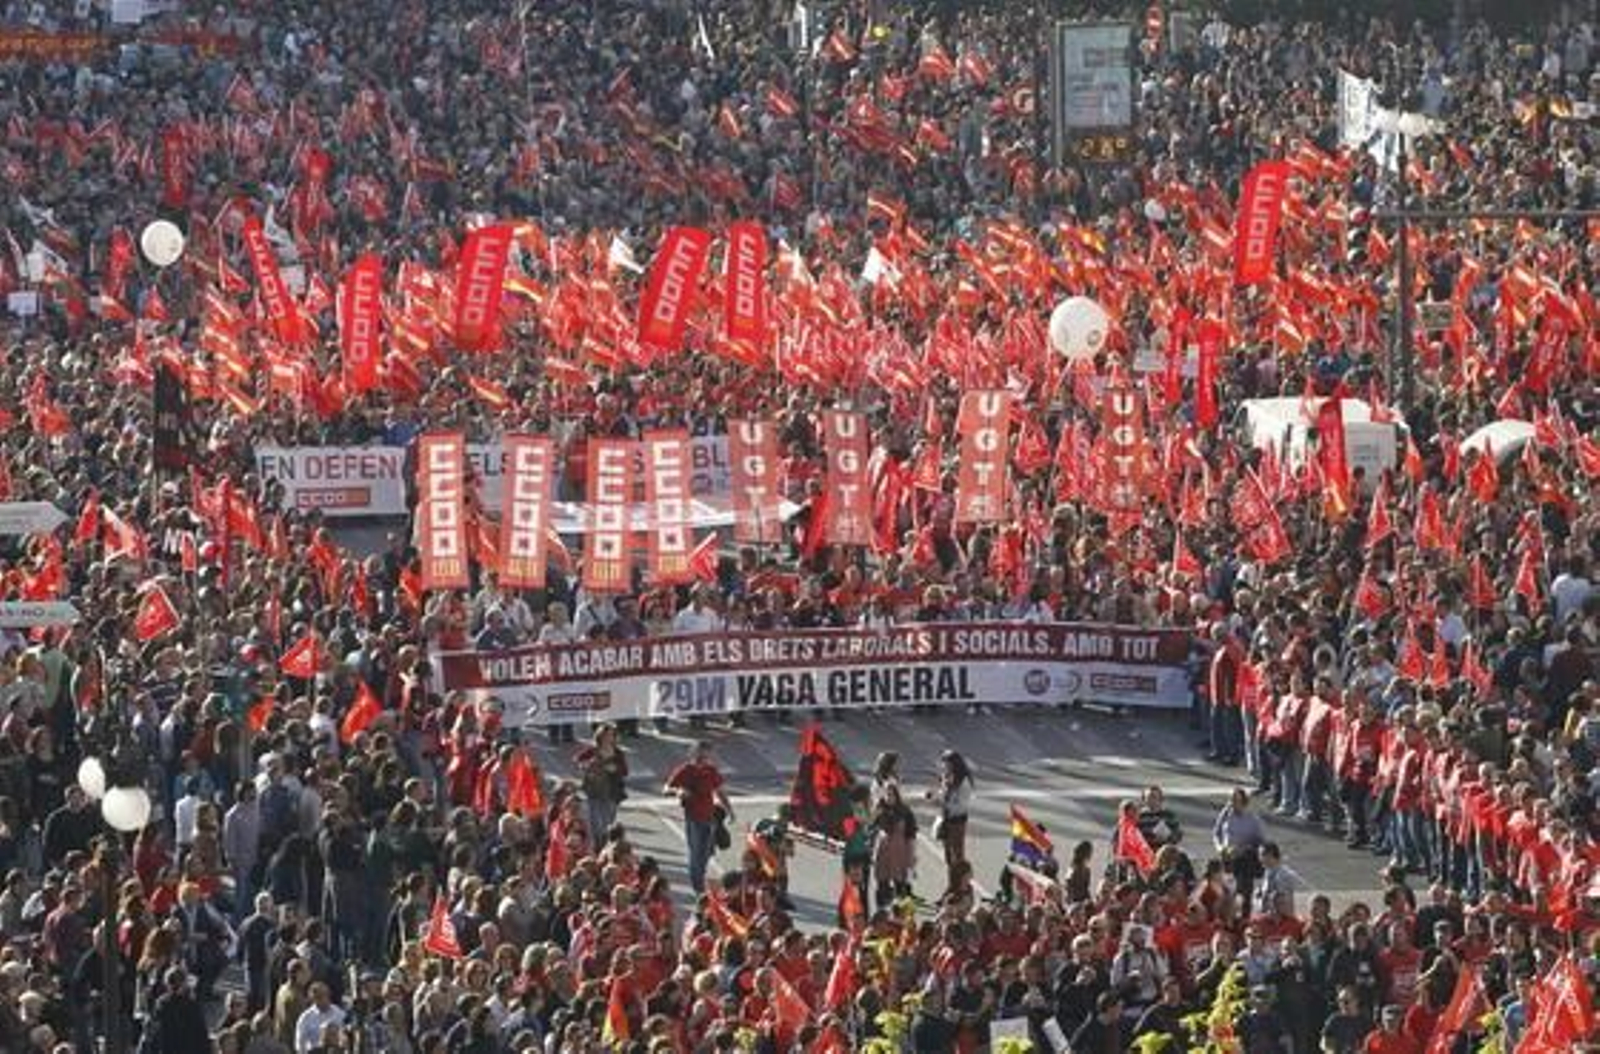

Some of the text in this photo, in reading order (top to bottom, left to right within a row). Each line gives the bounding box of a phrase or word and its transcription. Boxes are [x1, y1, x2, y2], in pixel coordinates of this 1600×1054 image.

[1247, 174, 1277, 258] CCOO
[350, 271, 374, 362] CCOO
[463, 236, 501, 325] CCOO
[654, 236, 699, 323] CCOO
[736, 233, 757, 317] CCOO
[835, 414, 859, 507] UGT
[973, 393, 1000, 486] UGT
[1113, 395, 1134, 476] UGT
[429, 443, 457, 557] CCOO
[510, 446, 545, 557] CCOO
[592, 448, 625, 559] CCOO
[653, 441, 685, 553] CCOO
[558, 645, 643, 675] ACABAR
[650, 641, 699, 668] AMB
[704, 639, 743, 663] ELS
[749, 636, 815, 661] DRETS
[821, 631, 931, 659] LABORALS
[1121, 637, 1160, 660] TOT
[656, 666, 976, 713] 29M VAGA GENERAL
